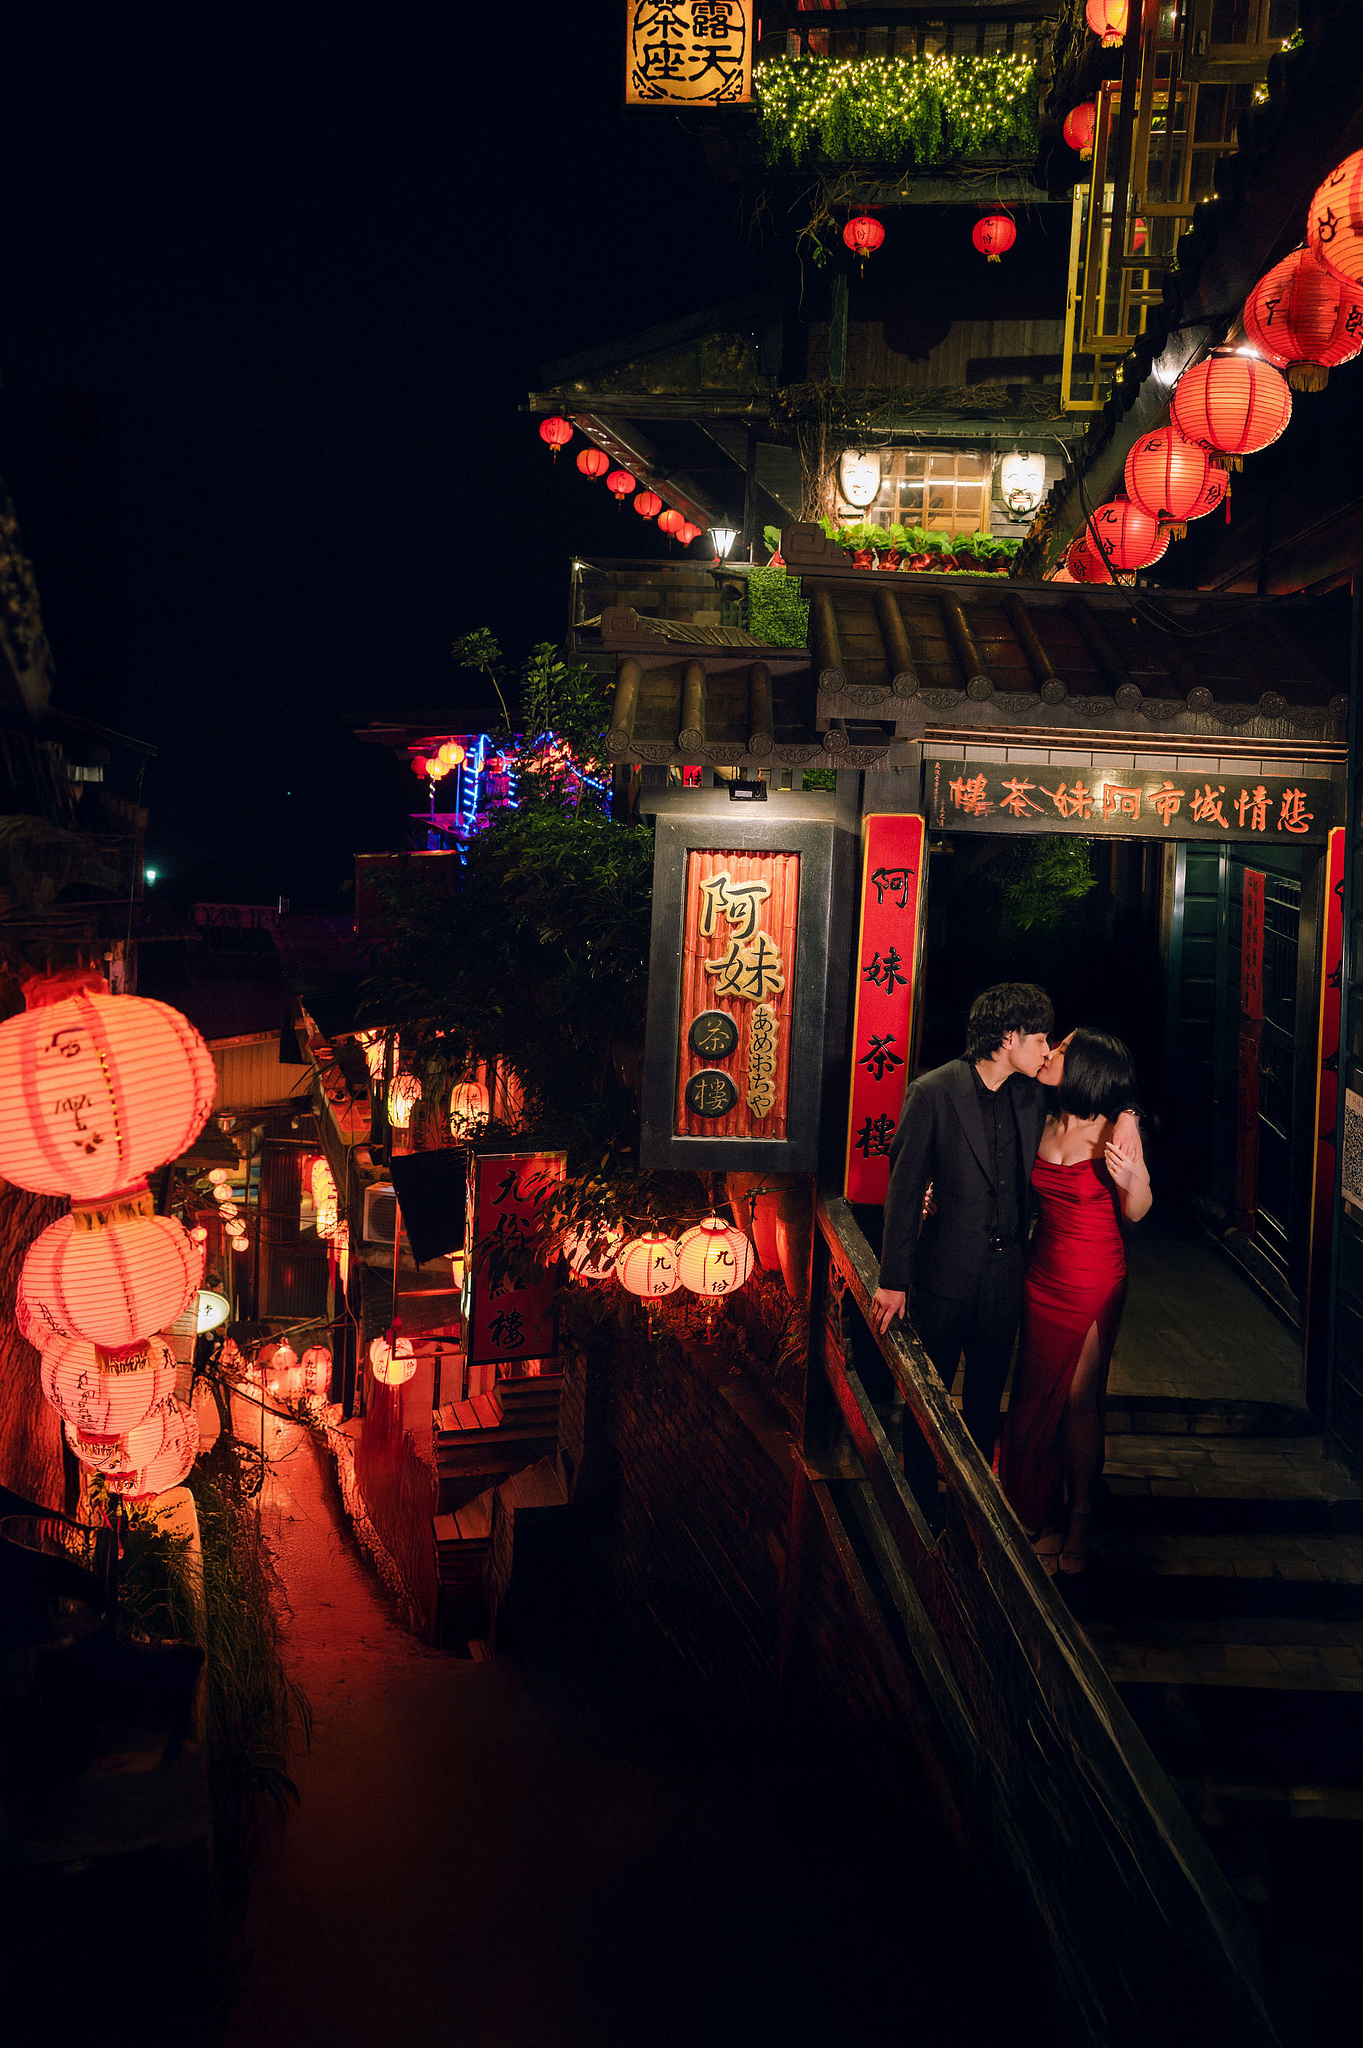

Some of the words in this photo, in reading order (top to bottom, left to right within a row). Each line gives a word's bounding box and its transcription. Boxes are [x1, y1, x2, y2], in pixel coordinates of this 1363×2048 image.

[703, 877, 780, 996] 阿妹
[855, 867, 915, 1159] 阿妹茶樓
[654, 1256, 671, 1294] 九份
[712, 1250, 734, 1293] 九份
